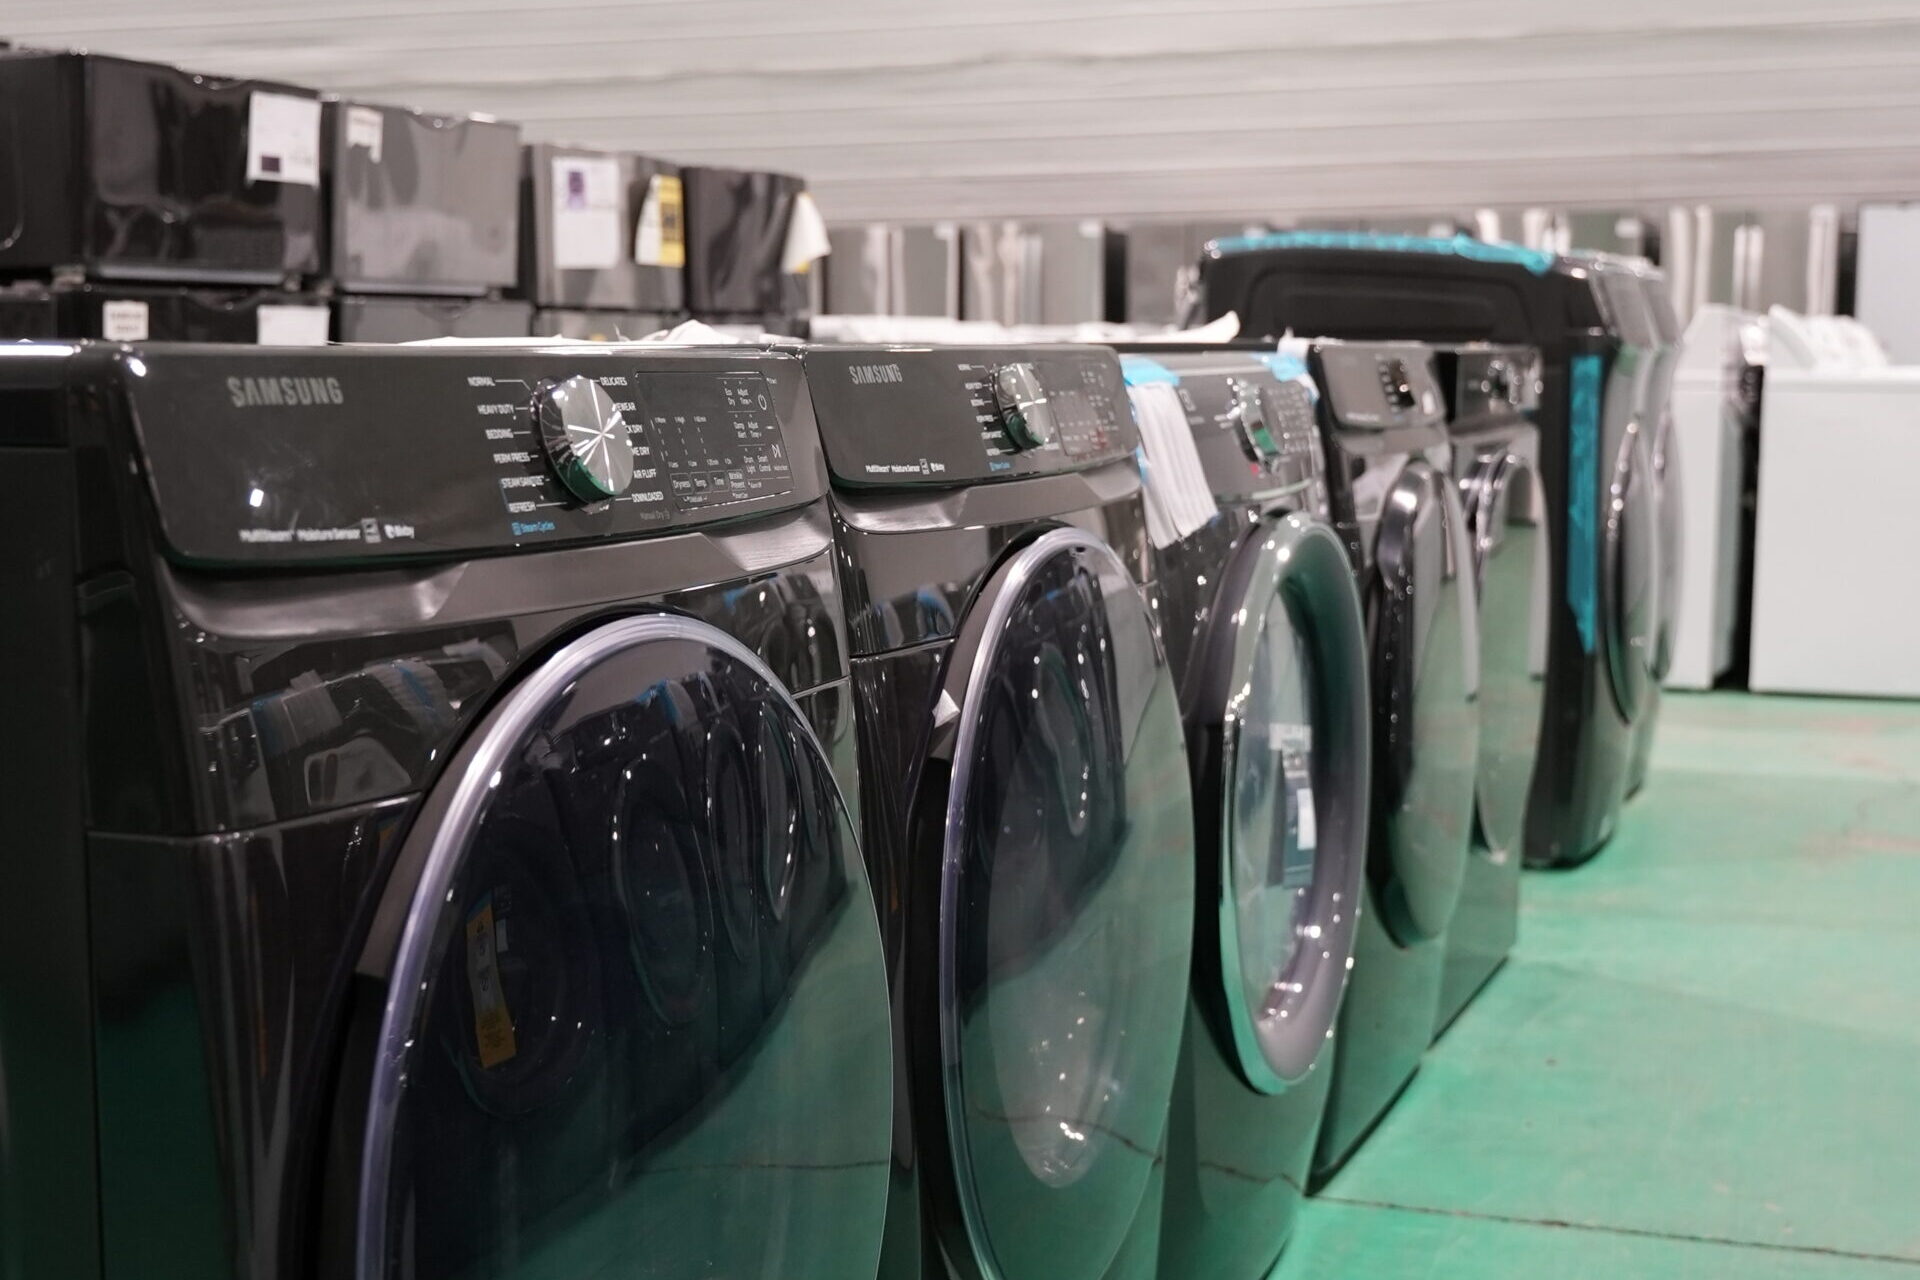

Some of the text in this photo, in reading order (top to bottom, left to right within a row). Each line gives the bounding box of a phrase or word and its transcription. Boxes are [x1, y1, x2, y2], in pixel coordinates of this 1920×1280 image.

[600, 376, 628, 386] DELICATES
[848, 363, 903, 385] SAMSUNG
[227, 375, 344, 407] SAMSUNG
[631, 491, 664, 503] DOWNLOADED
